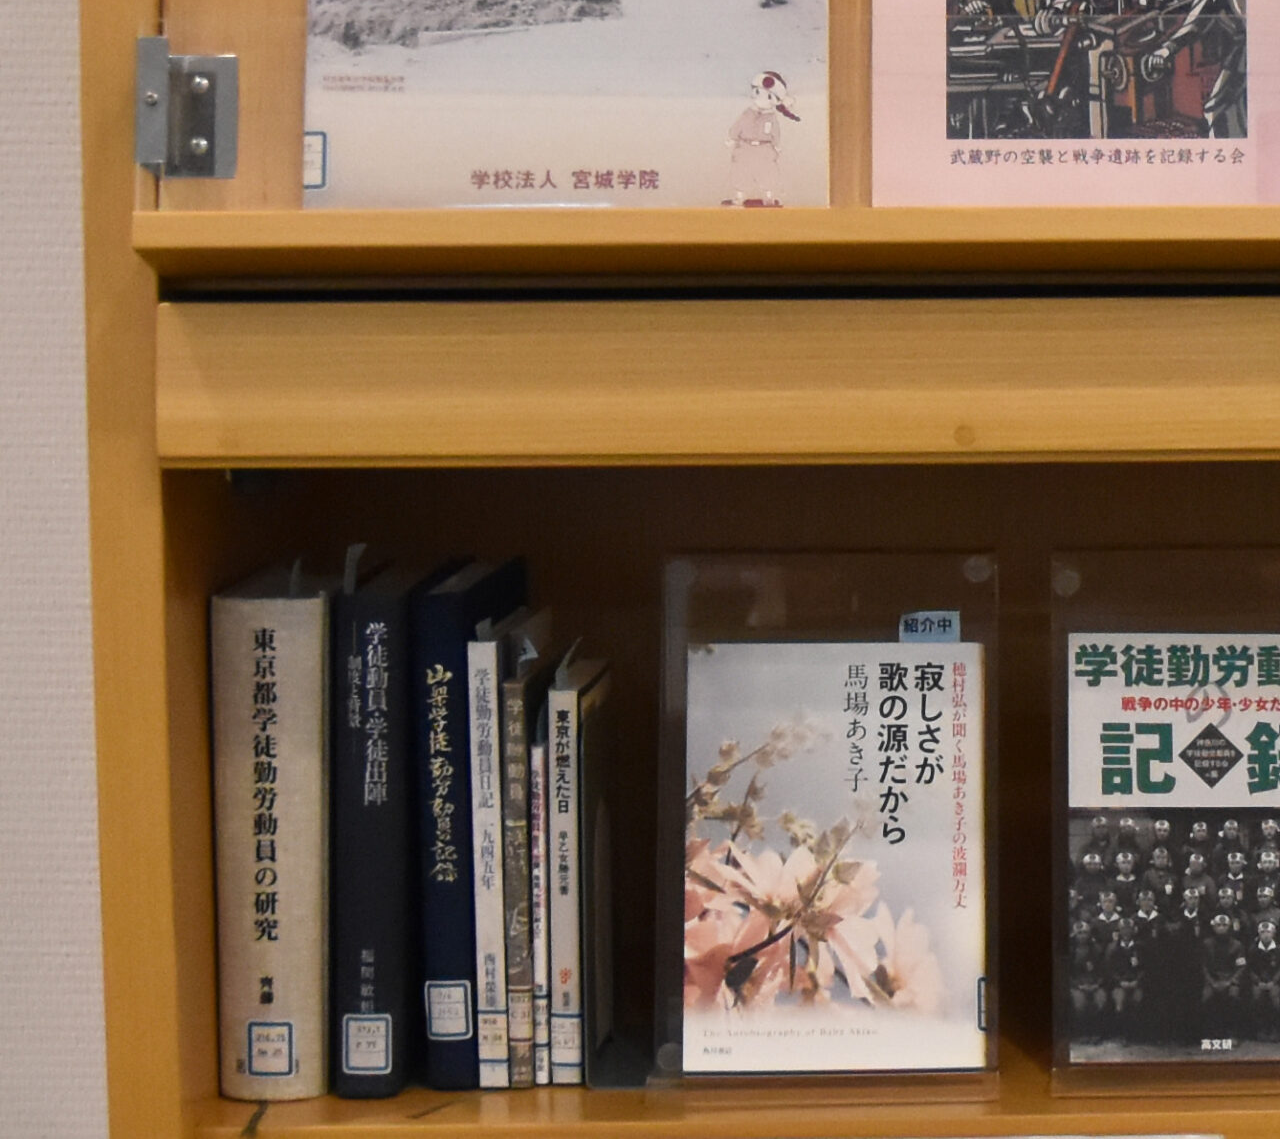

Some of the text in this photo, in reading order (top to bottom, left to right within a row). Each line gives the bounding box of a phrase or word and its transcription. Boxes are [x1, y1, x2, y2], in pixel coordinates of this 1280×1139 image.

[471, 168, 661, 191] 学校法人 宮城学院
[949, 147, 1246, 165] 武蔵野の空襲と戦争遺跡を記録する会
[903, 617, 953, 634] 紹介中
[363, 621, 390, 806] 学徒動員・学徒出陣
[554, 709, 572, 815] 東京が燃えた日
[843, 664, 869, 793] 馬場あき子
[877, 661, 909, 845] 歌の源だから
[913, 661, 945, 785] 寂しさが
[1100, 722, 1177, 796] 記
[251, 627, 280, 942] 東京都学徒勤労動員の研究
[951, 661, 968, 909] 穂村弘が聞く馬場あき子の波瀾万丈
[1201, 1038, 1233, 1050] 高文研
